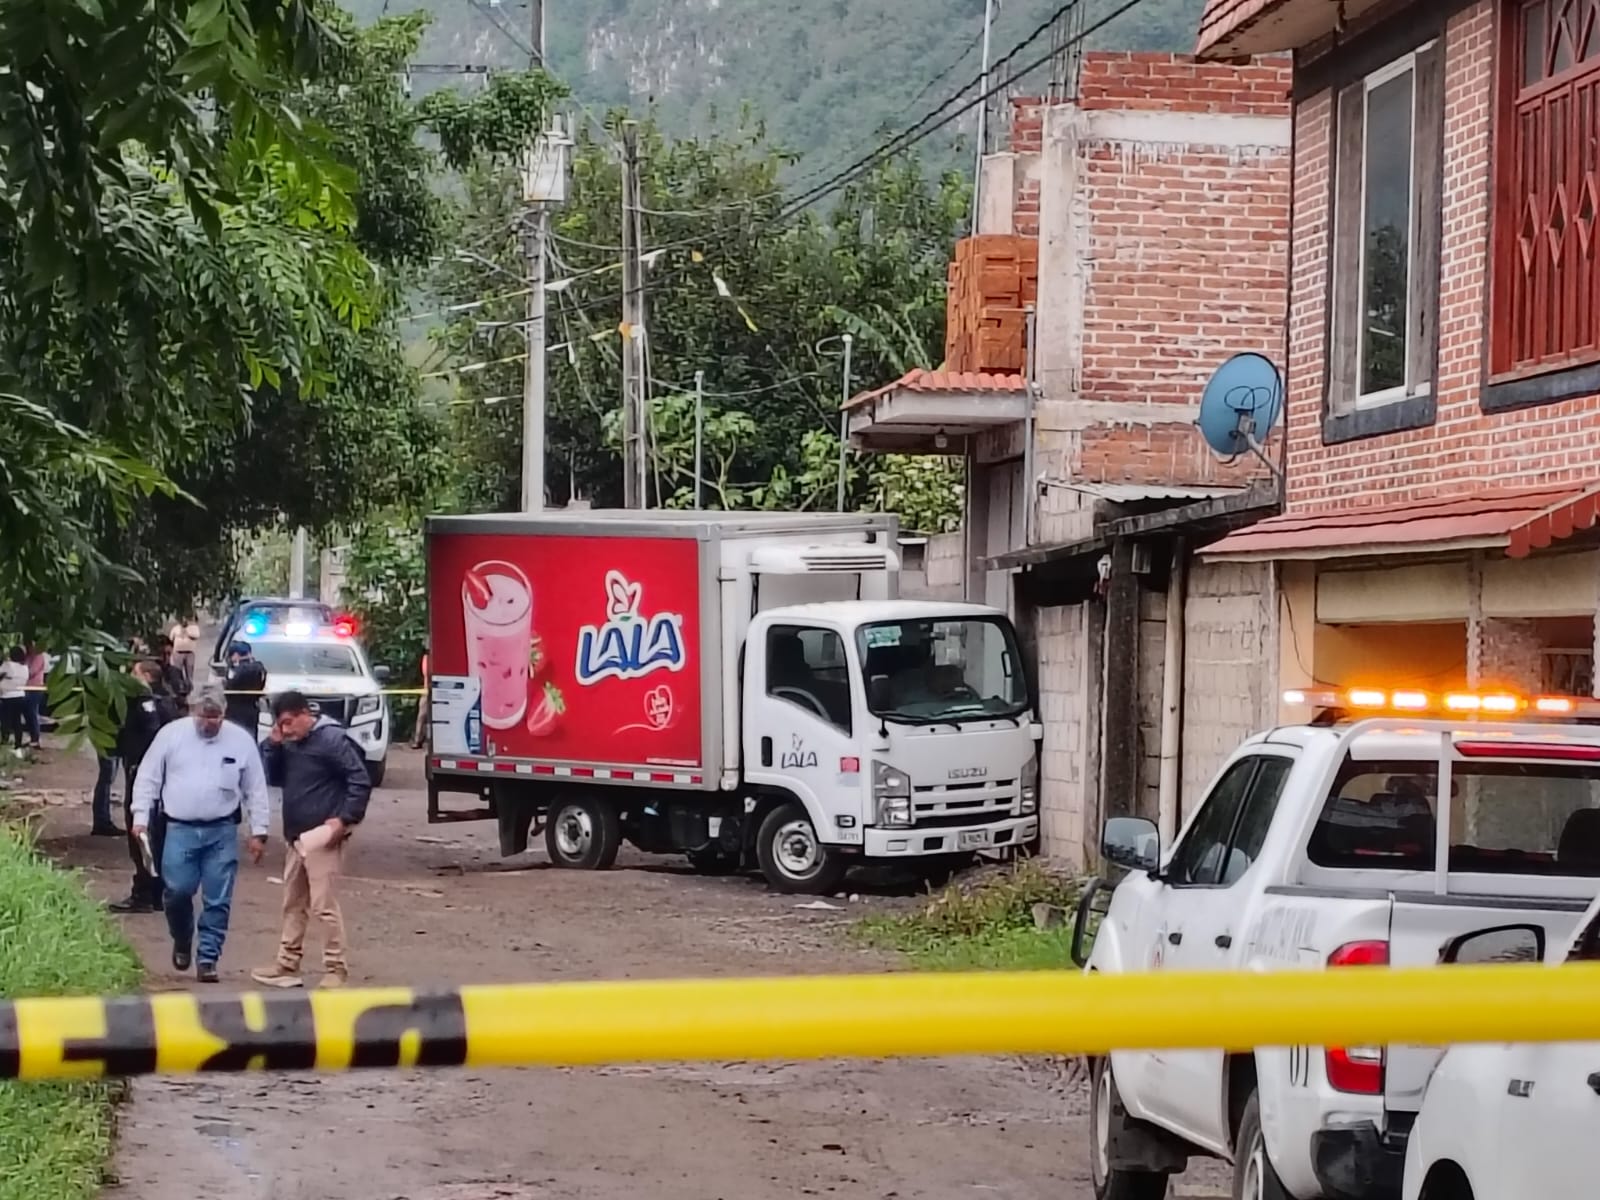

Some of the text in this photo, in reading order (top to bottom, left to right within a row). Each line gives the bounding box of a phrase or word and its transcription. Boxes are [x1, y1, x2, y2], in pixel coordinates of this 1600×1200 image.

[577, 614, 684, 683] LALA
[781, 751, 818, 769] LALA
[947, 767, 988, 779] ISUZU
